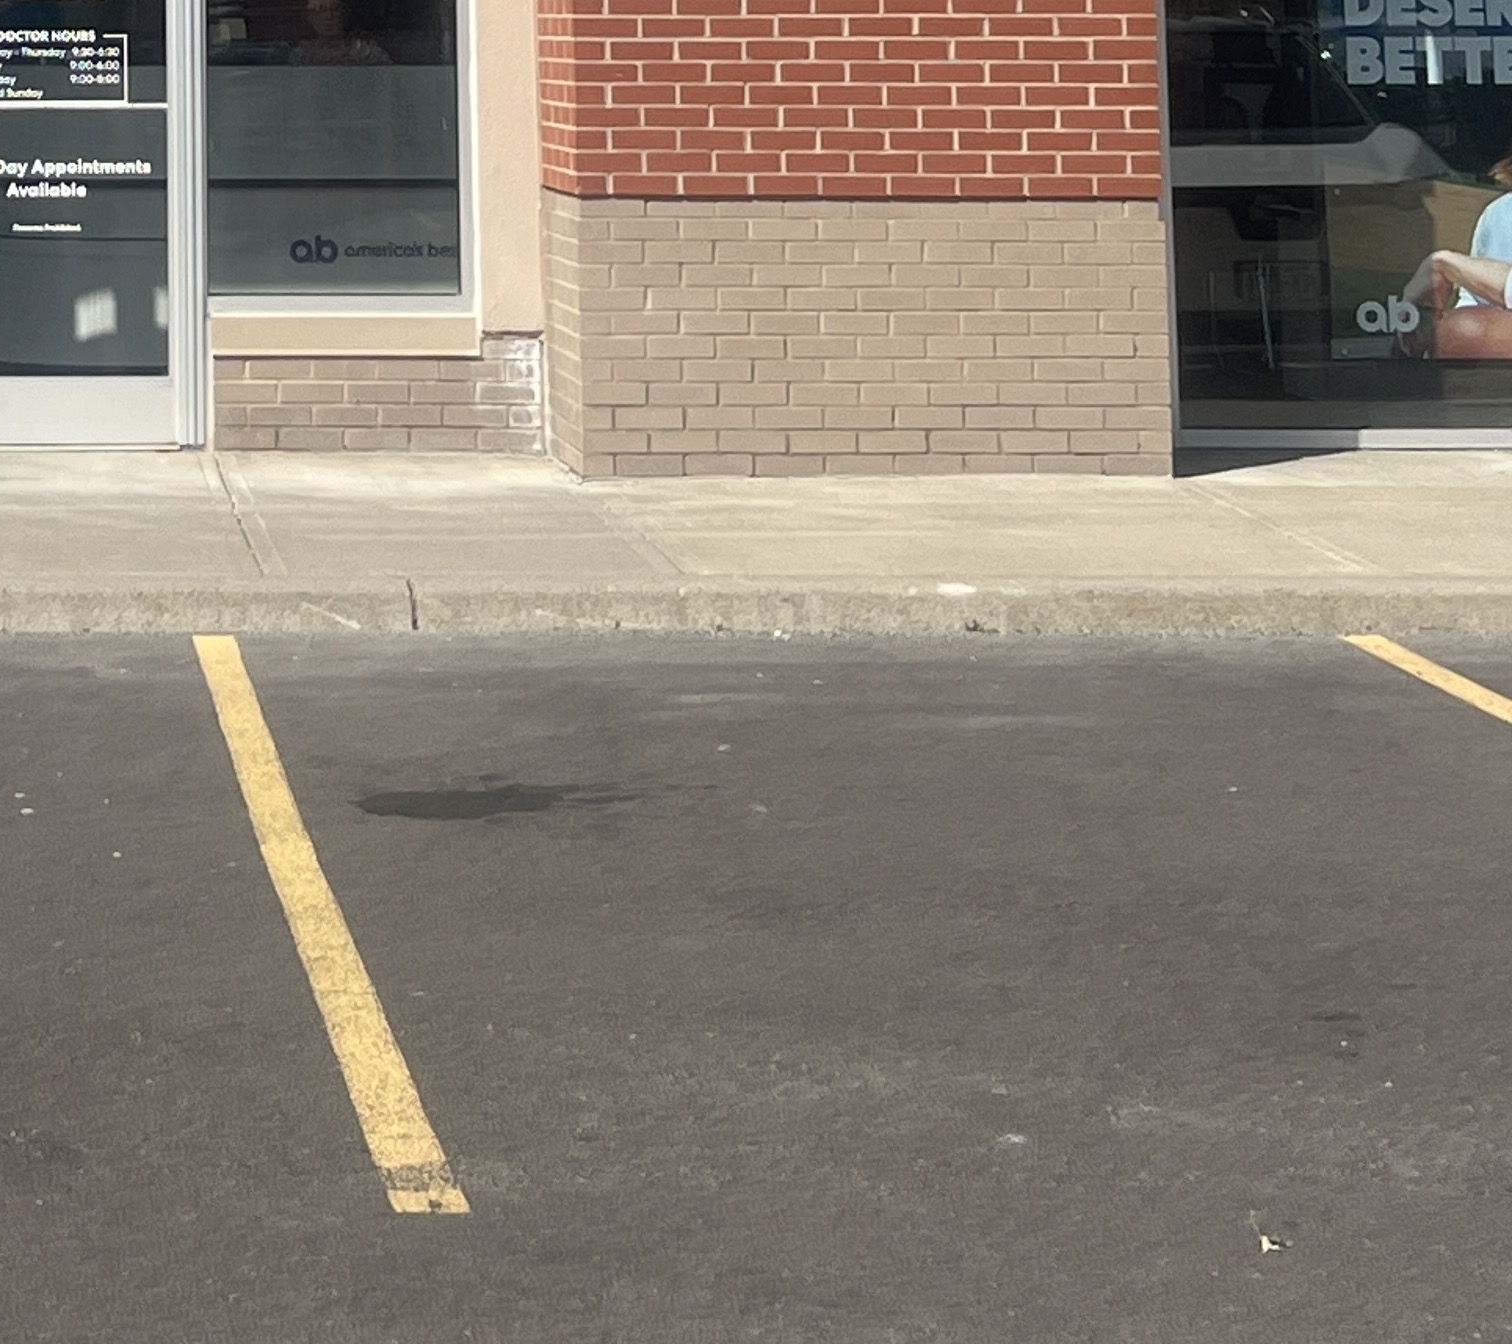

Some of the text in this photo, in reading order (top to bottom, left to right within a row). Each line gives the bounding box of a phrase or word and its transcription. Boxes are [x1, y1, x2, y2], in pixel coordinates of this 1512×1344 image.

[51, 30, 96, 42] HOURS
[22, 47, 66, 58] Thursday
[6, 88, 43, 99] Sunday
[31, 158, 151, 178] Appointments
[6, 182, 86, 197] Available
[291, 235, 339, 264] ab
[1356, 294, 1420, 334] ab
